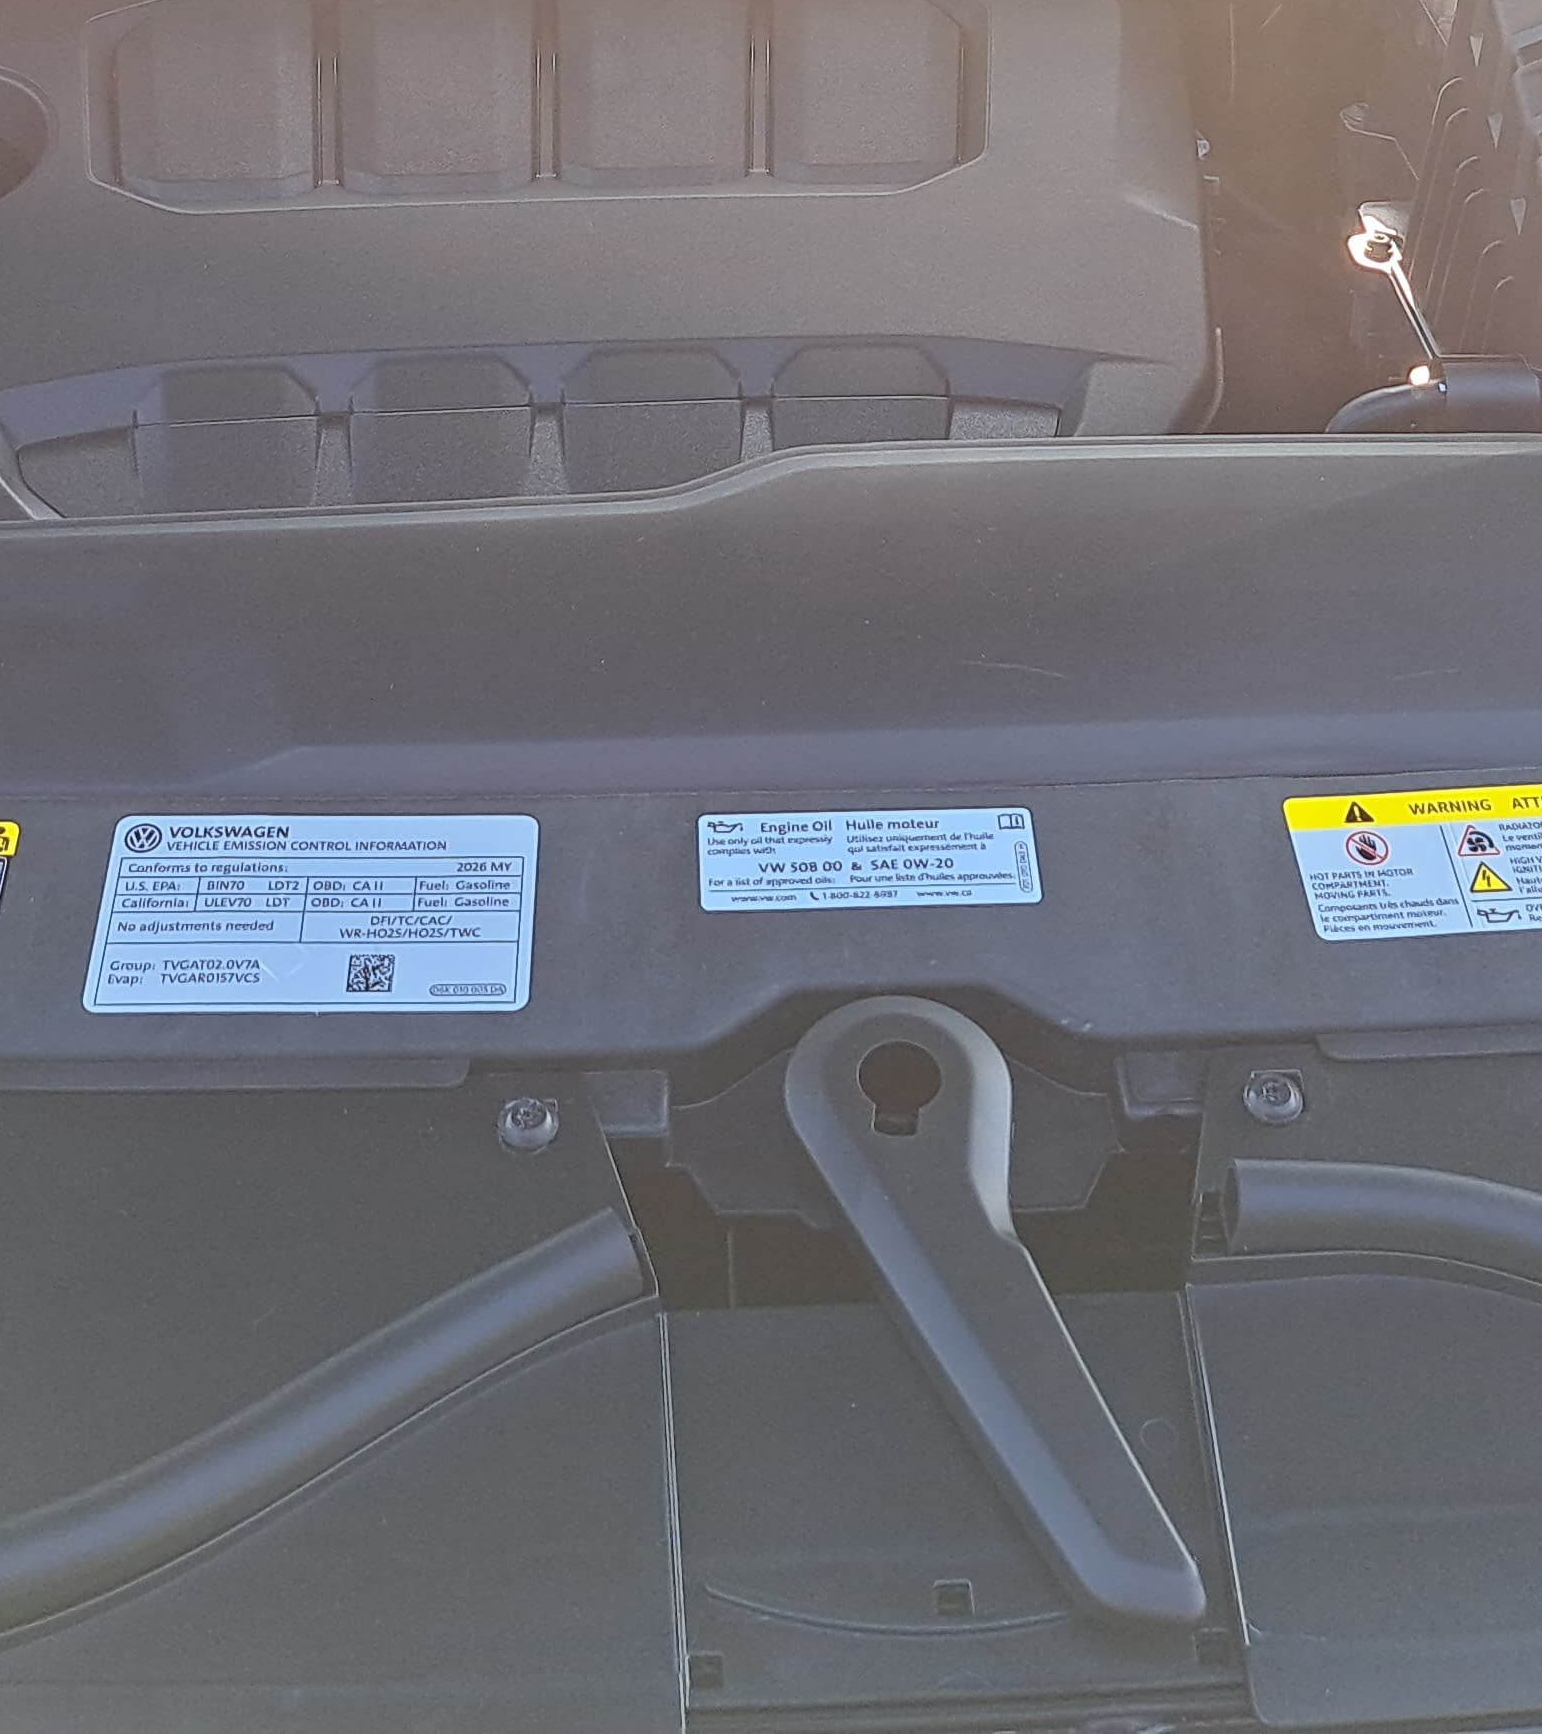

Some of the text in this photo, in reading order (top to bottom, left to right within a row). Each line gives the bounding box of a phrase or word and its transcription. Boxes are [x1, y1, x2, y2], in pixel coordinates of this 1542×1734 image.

[1408, 799, 1492, 815] WARNING
[761, 820, 832, 835] Engine Oil
[846, 819, 939, 831] Huile moteur
[169, 826, 289, 838] VOLKSWAGEN
[728, 838, 747, 847] only
[847, 835, 883, 843] Utilisez
[886, 834, 947, 844] uniquement
[964, 832, 994, 840] l'huile
[1503, 834, 1513, 842] Le
[167, 840, 447, 850] VEHICLE EMISSION CONTROL INFORMATION
[867, 844, 905, 852] satisfait
[758, 857, 955, 873] VW 508 00 & SAE 0W-20
[1510, 855, 1534, 865] HIGH
[129, 863, 190, 873] Conforms
[194, 863, 208, 872] to
[457, 862, 512, 872] 2026 MY
[850, 874, 872, 882] Pour
[1332, 871, 1362, 879] PARTS
[1377, 868, 1414, 877] MOTOR
[126, 882, 180, 891] U.S. EPA:
[207, 881, 299, 890] BIN70 LDT2
[313, 881, 346, 891] OBD:
[353, 881, 371, 890] CA
[419, 880, 511, 890] Fuel: Gasoline
[709, 878, 724, 887] For
[753, 877, 763, 885] of
[1315, 890, 1355, 900] MOVING
[122, 897, 189, 908] California:
[204, 898, 290, 907] ULEV70 LDT
[311, 898, 344, 908] OBD:
[351, 898, 369, 907] CA
[418, 897, 510, 907] Fuel: Gasoline
[1436, 898, 1459, 906] dans
[371, 916, 453, 925] DFI/TC/CAC/
[1333, 912, 1404, 922] compartiment
[117, 920, 274, 934] No adjustments needed
[110, 960, 155, 972] Group:
[108, 974, 143, 986] Evap:
